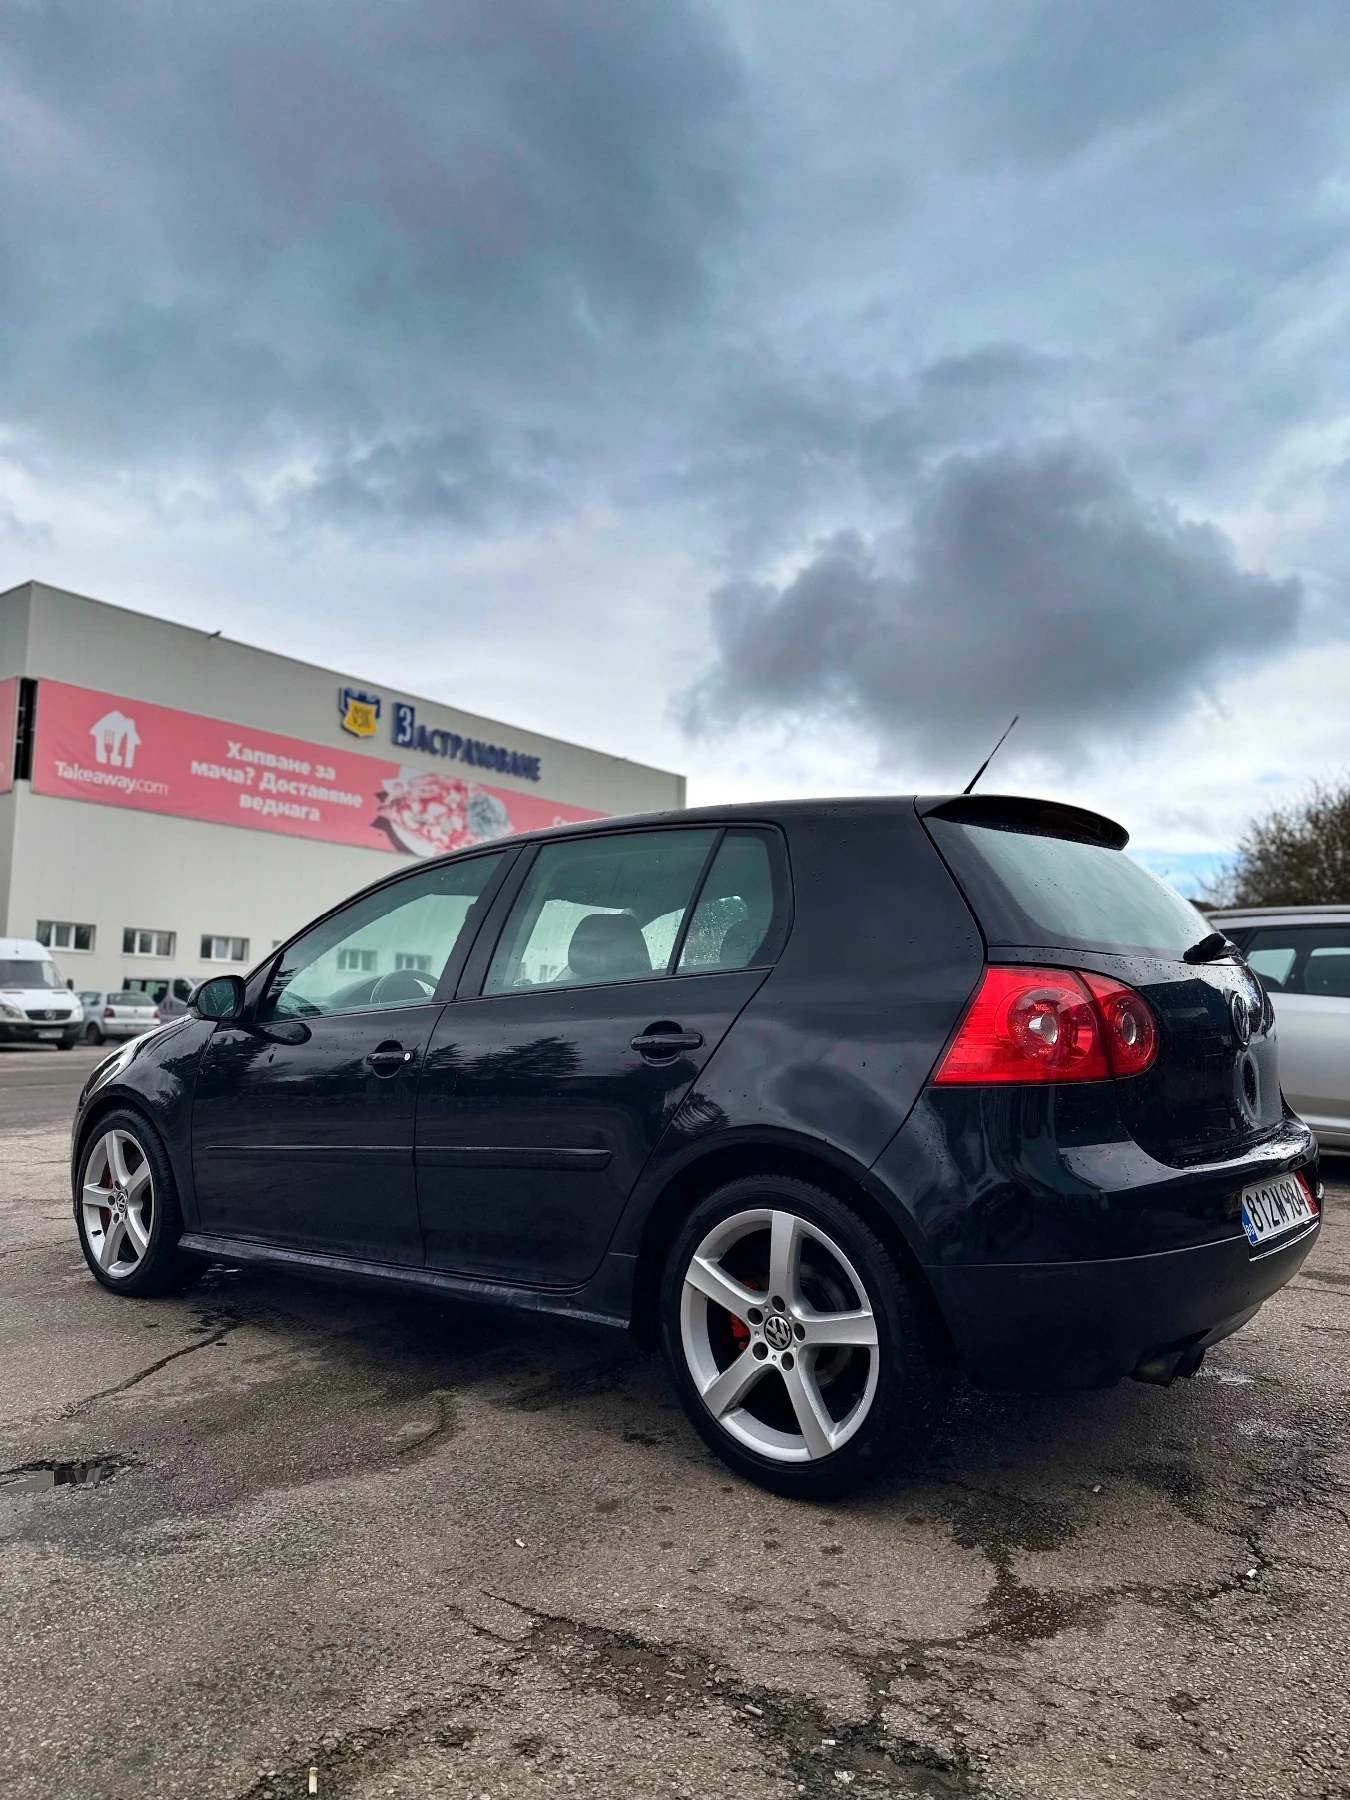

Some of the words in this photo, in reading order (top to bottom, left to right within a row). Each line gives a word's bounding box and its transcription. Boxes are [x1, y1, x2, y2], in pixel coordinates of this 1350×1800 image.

[54, 760, 169, 795] Takeaway.com
[227, 740, 311, 775] Хапване
[315, 764, 336, 781] за
[239, 794, 320, 821] веднага
[259, 772, 363, 808] Доставяме
